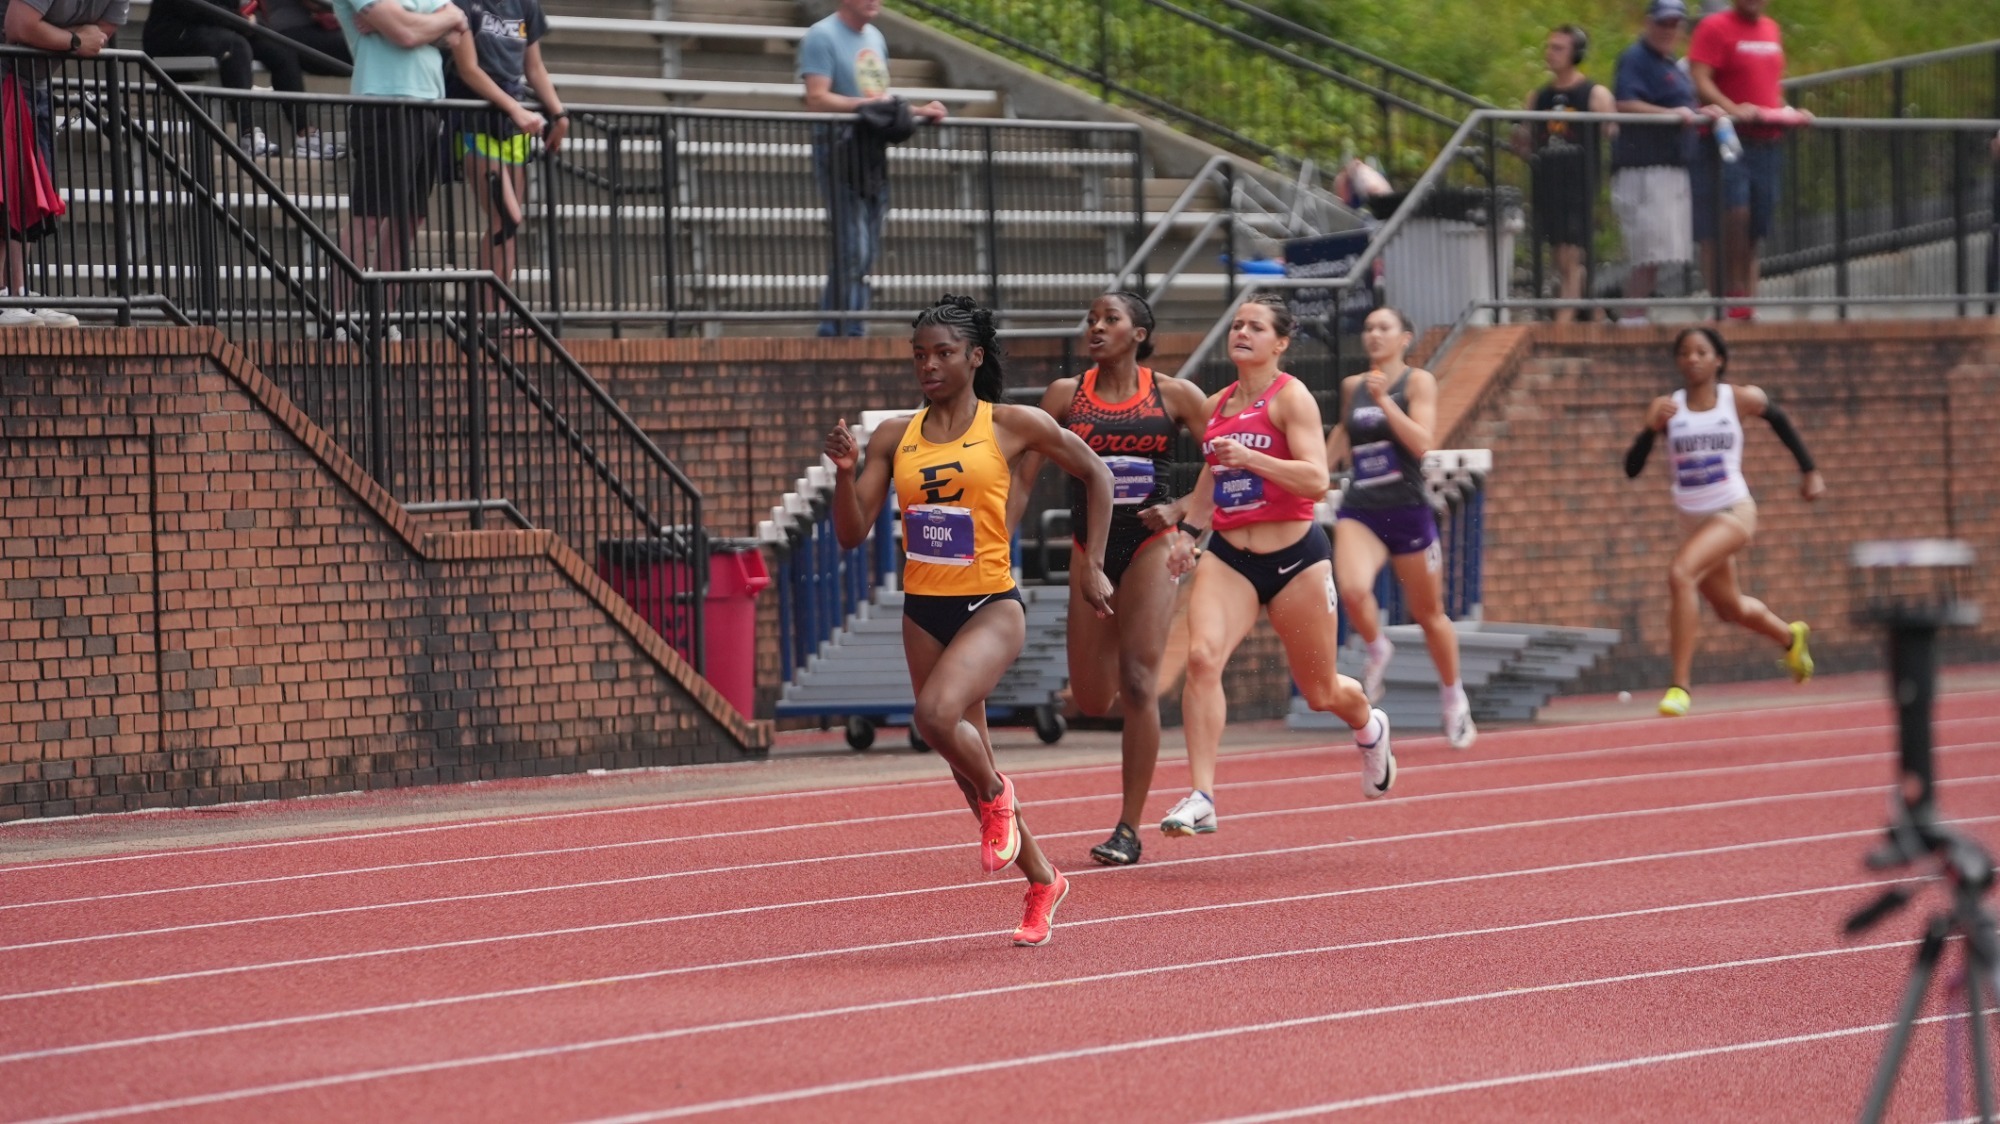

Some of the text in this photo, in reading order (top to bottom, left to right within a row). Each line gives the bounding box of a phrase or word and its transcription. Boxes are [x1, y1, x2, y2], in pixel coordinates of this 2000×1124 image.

[1068, 422, 1169, 452] Mercer
[919, 461, 965, 504] E
[1222, 478, 1253, 494] PARDUE
[923, 525, 953, 541] COOK
